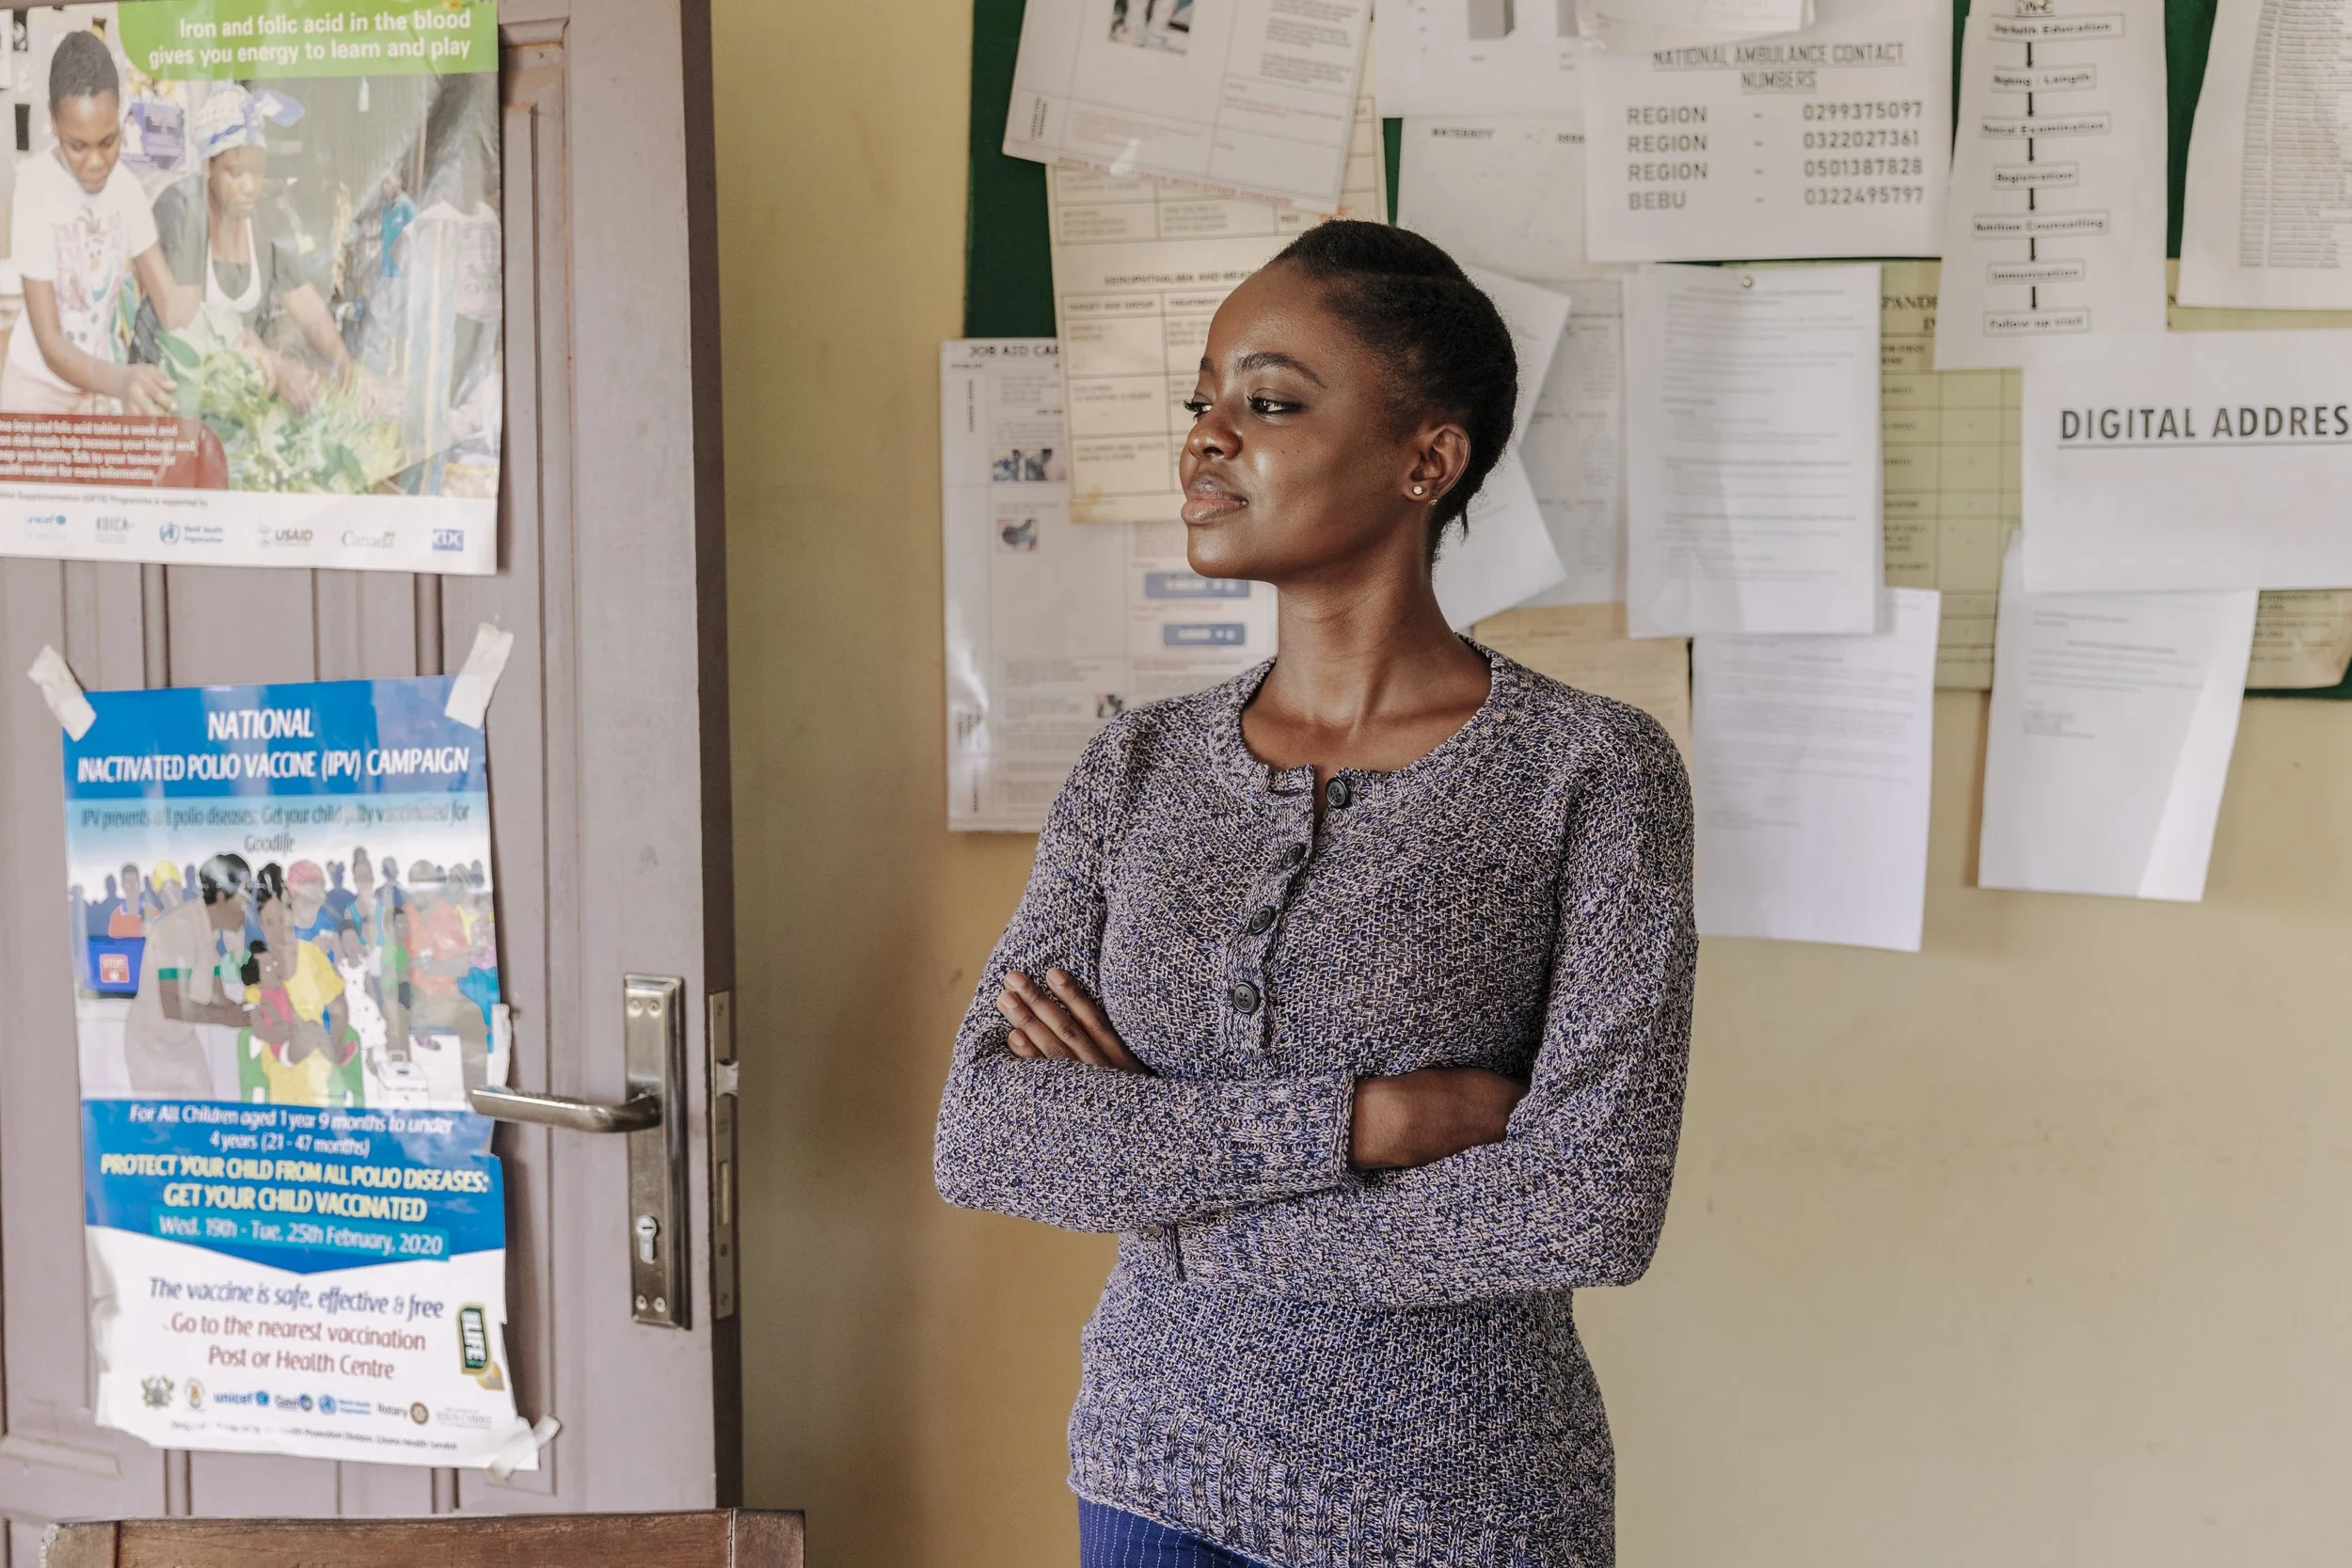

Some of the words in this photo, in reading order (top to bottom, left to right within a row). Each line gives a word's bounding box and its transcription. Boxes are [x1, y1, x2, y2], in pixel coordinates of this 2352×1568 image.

[180, 18, 216, 38] Iron
[222, 18, 253, 37] and
[258, 15, 297, 35] folic
[304, 13, 343, 33] acid
[350, 13, 369, 32] in
[373, 11, 407, 31] the
[414, 8, 470, 29] blood
[150, 45, 194, 70] gives
[200, 48, 232, 70] you
[237, 45, 298, 64] energy
[305, 42, 325, 60] to
[331, 40, 380, 59] learn
[388, 38, 423, 56] and
[432, 37, 470, 60] play
[1652, 49, 1727, 66] NATIONAL
[1734, 44, 1826, 64] AMBULANCE
[1833, 42, 1904, 62] CONTACT
[1741, 71, 1817, 89] NUMBERS
[1628, 104, 1708, 125] REGION
[1804, 100, 1923, 120] 0299375097
[1628, 134, 1708, 154] REGION
[1804, 129, 1919, 149] 0322027361
[1628, 162, 1708, 182] REGION
[1804, 157, 1923, 177] 0501387828
[1629, 191, 1687, 211] BEBU
[1804, 185, 1924, 205] 0322495797
[2061, 407, 2196, 439] DIGITAL
[275, 530, 313, 543] USAID
[342, 530, 394, 549] Canada
[207, 708, 314, 741] NATIONAL
[187, 754, 240, 782] POLIO
[245, 750, 317, 780] VACCINE
[322, 749, 361, 783] (IPV)
[366, 747, 469, 776] CAMPAIGN
[130, 1104, 154, 1123] For
[157, 1104, 180, 1123] All
[182, 1104, 238, 1126] Children
[240, 1109, 277, 1131] aged
[288, 1113, 316, 1132] year
[319, 1112, 329, 1130] 9
[331, 1115, 386, 1132] months
[389, 1116, 405, 1132] to
[407, 1117, 453, 1134] under
[210, 1130, 220, 1148] 4
[220, 1132, 259, 1153] years
[261, 1132, 285, 1153] (21
[294, 1134, 312, 1152] 47
[313, 1137, 370, 1160] months)
[101, 1153, 179, 1176] PROTECT
[180, 1154, 225, 1179] YOUR
[226, 1157, 274, 1180] CHILD
[275, 1160, 323, 1182] FROM
[324, 1163, 350, 1186] ALL
[351, 1164, 404, 1189] POLIO
[164, 1182, 202, 1207] GET
[203, 1184, 256, 1212] YOUR
[258, 1186, 313, 1213] CHILD
[315, 1190, 427, 1223] VACCINATED
[159, 1213, 201, 1237] Wed.
[205, 1216, 238, 1239] 19th
[250, 1219, 284, 1243] Tue.
[286, 1222, 324, 1244] 25th
[326, 1225, 395, 1257] February,
[398, 1232, 444, 1256] 2020
[150, 1276, 183, 1299] The
[187, 1279, 254, 1304] vaccine
[256, 1281, 270, 1305] is
[318, 1286, 389, 1316] effective
[392, 1295, 405, 1315] &
[405, 1293, 445, 1323] free
[171, 1311, 198, 1334] Go
[200, 1315, 219, 1336] to
[224, 1315, 253, 1337] the
[258, 1320, 322, 1341] nearest
[326, 1325, 426, 1352] vaccination
[208, 1343, 246, 1368] Post
[251, 1350, 271, 1369] or
[276, 1350, 335, 1374] Health
[340, 1354, 395, 1380] Centre
[214, 1393, 253, 1404] unicef
[378, 1403, 407, 1419] Rotary
